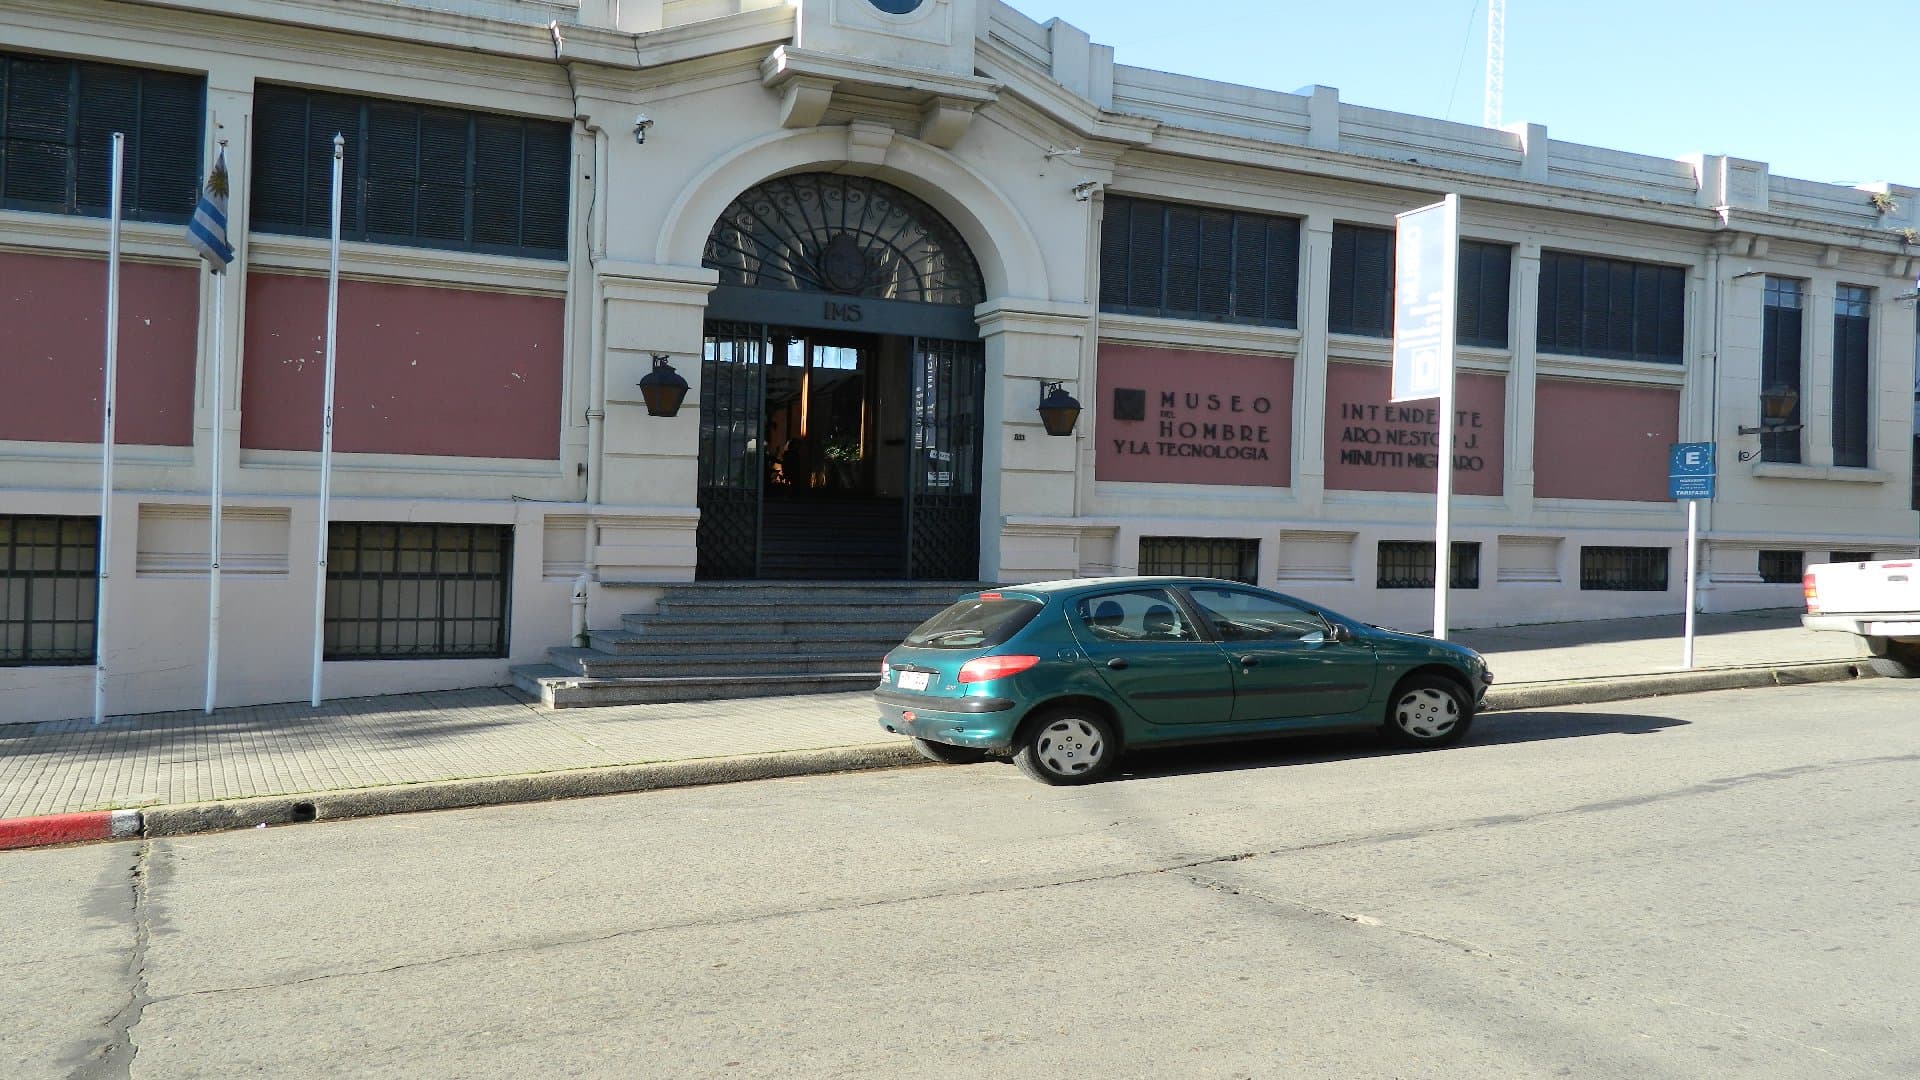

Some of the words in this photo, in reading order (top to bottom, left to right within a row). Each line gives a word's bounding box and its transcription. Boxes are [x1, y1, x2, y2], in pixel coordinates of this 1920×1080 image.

[824, 301, 863, 322] IMS
[1160, 392, 1271, 413] MUSEO
[1160, 410, 1176, 419] DEL
[1341, 403, 1482, 428] INTENDETE
[1159, 420, 1270, 443] HOMBRE
[1386, 429, 1456, 448] NESTO
[1113, 439, 1126, 455] Y
[1130, 441, 1150, 456] LA
[1157, 441, 1269, 461] TECNOLOGIA
[1340, 448, 1404, 468] MINUTTI
[1686, 451, 1700, 465] E
